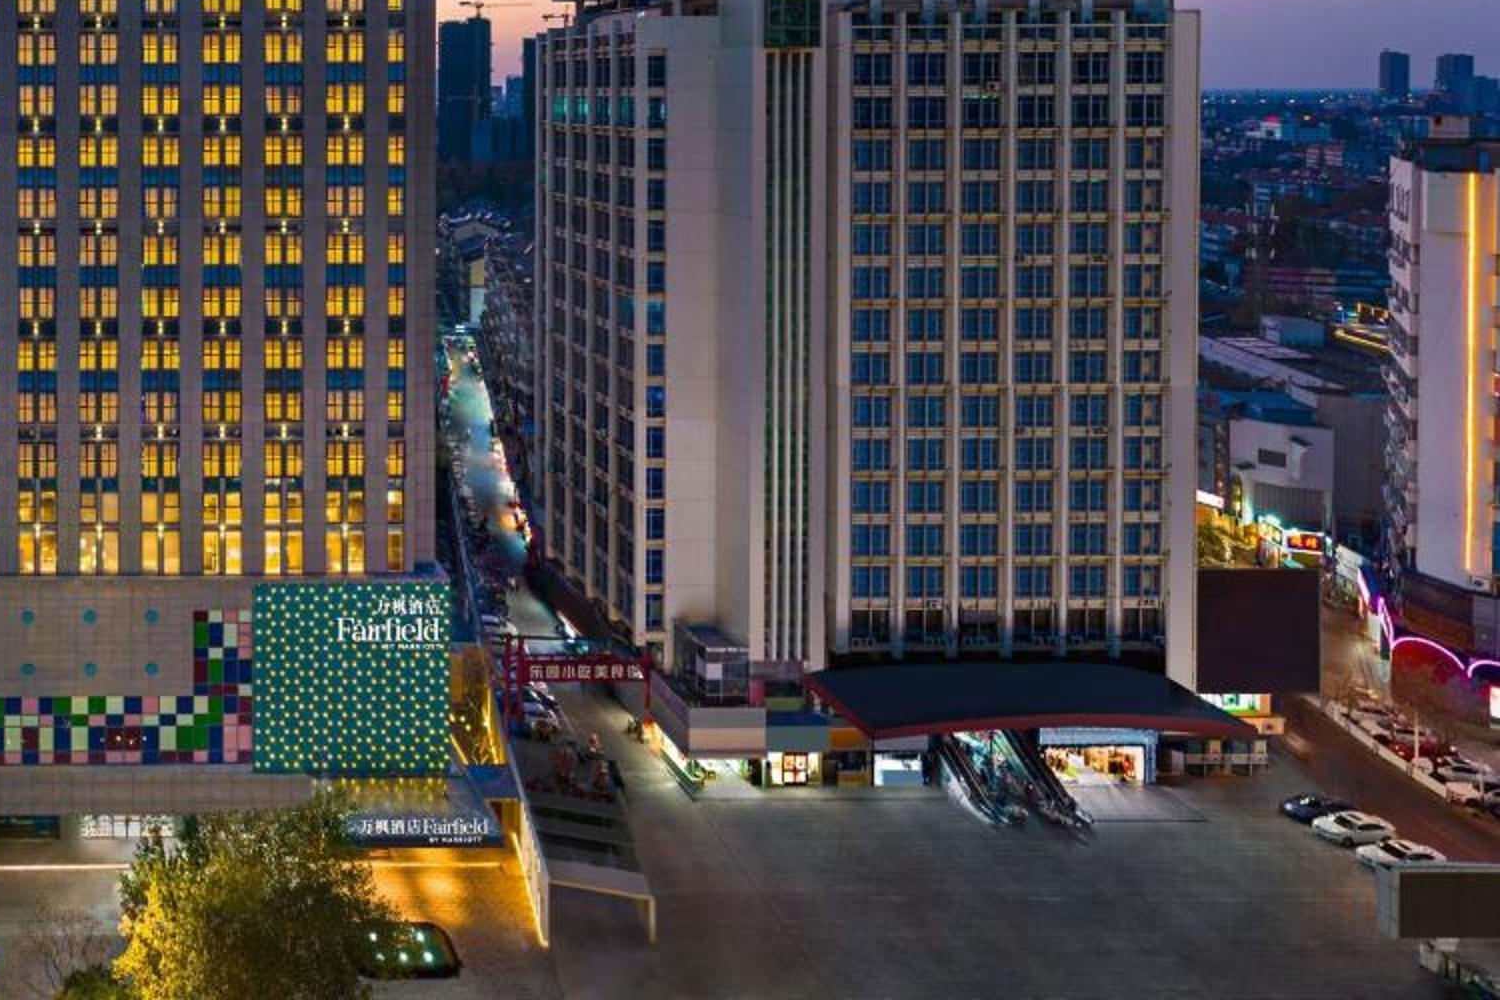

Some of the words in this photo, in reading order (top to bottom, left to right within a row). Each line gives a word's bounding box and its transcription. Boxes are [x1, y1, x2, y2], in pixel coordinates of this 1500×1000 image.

[373, 598, 443, 615] 万枫酒店
[336, 617, 440, 642] Fairfield
[359, 818, 421, 836] 万枫酒店
[422, 818, 489, 836] Fairfield
